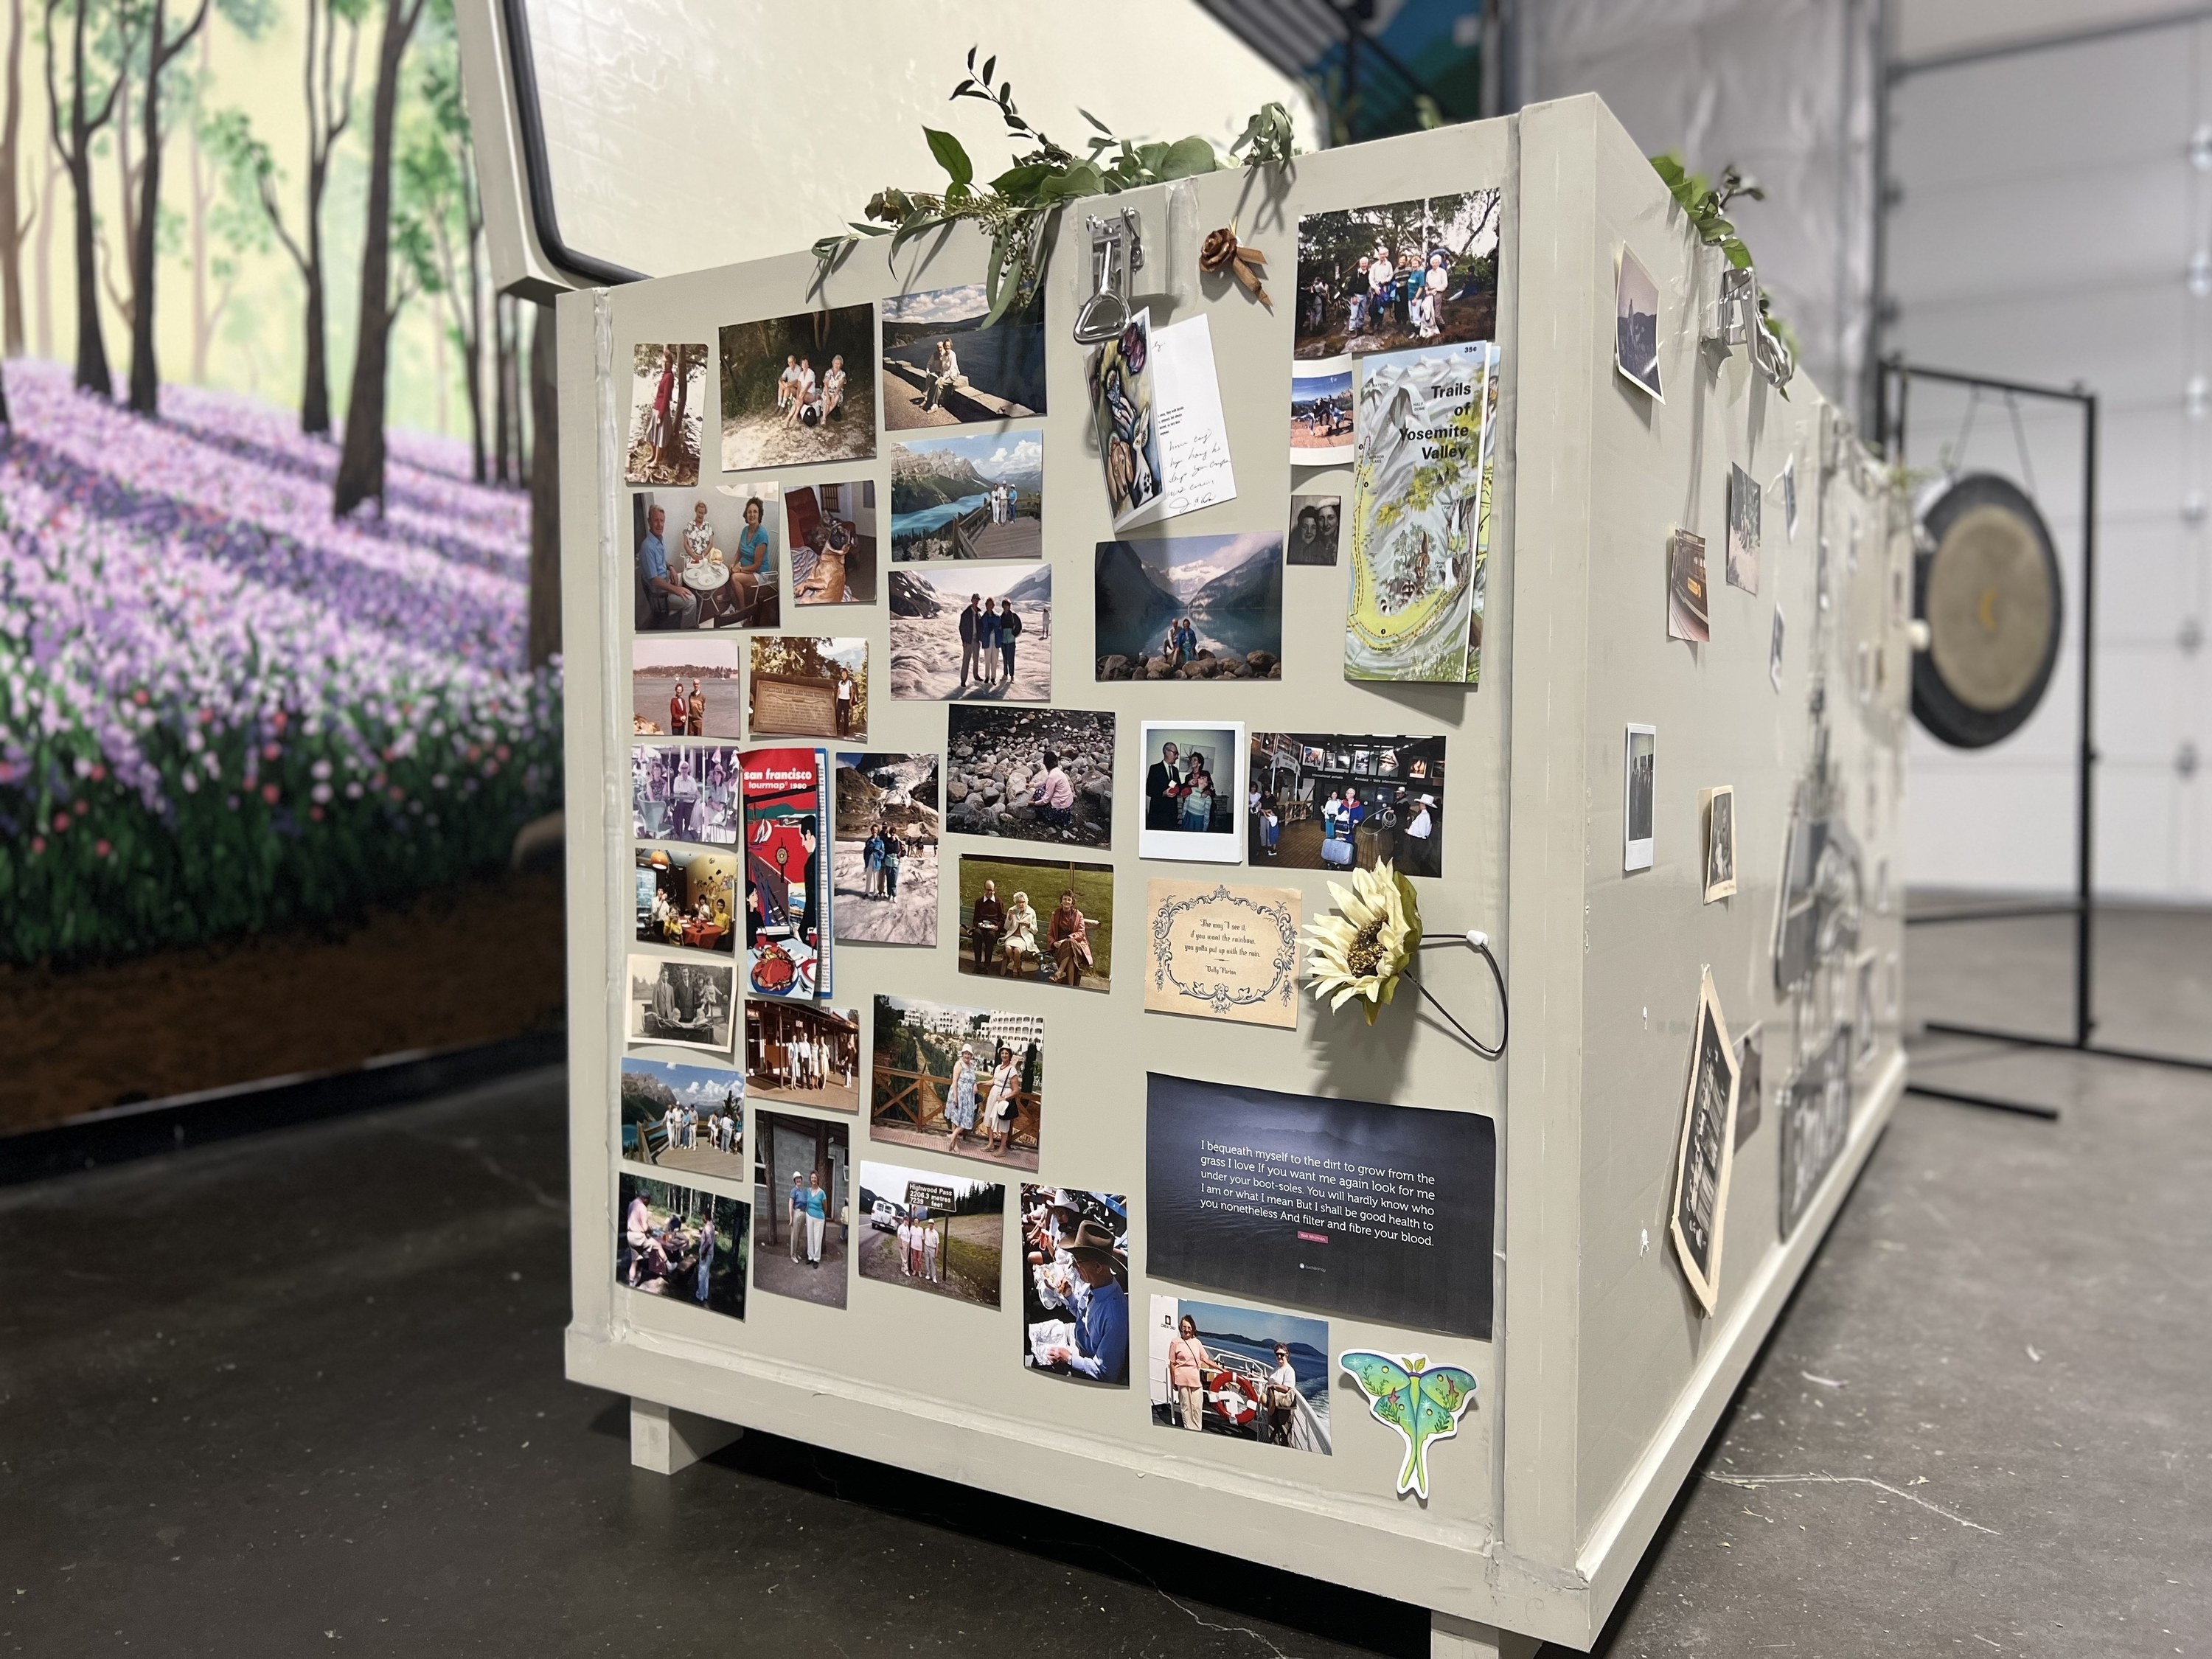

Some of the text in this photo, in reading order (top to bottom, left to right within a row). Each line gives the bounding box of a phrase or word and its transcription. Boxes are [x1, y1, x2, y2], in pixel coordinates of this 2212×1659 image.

[1431, 383, 1471, 398] Trails
[1454, 402, 1471, 417] of
[1399, 425, 1469, 441] Yosemite
[1422, 446, 1467, 460] Valley
[743, 768, 812, 780] san francisco
[1200, 919, 1211, 928] The
[1224, 921, 1230, 929] I
[1227, 947, 1237, 955] with
[1239, 947, 1248, 956] the
[1205, 965, 1237, 975] Dolly Parton
[1201, 1140, 1435, 1184] I bequeath myself to the dirt to grow from the
[1200, 1156, 1435, 1200] grass I love If you want me again look for me
[909, 1183, 938, 1193] Highwood
[1200, 1171, 1435, 1215] under your boot-soles. You will hardly know who
[910, 1190, 951, 1203] 2206.3 metres
[1201, 1183, 1205, 1192] I
[1206, 1186, 1221, 1194] am
[1235, 1190, 1259, 1202] what
[1261, 1193, 1265, 1202] I
[1267, 1195, 1293, 1207] mean
[1296, 1199, 1312, 1211] But
[1315, 1202, 1318, 1211] I
[1320, 1203, 1342, 1215] shall
[1345, 1207, 1357, 1218] be
[1360, 1212, 1386, 1222] good
[1389, 1214, 1420, 1228] health
[1423, 1221, 1434, 1231] to
[1200, 1199, 1434, 1246] you nonetheless And filter and fibre your blood.
